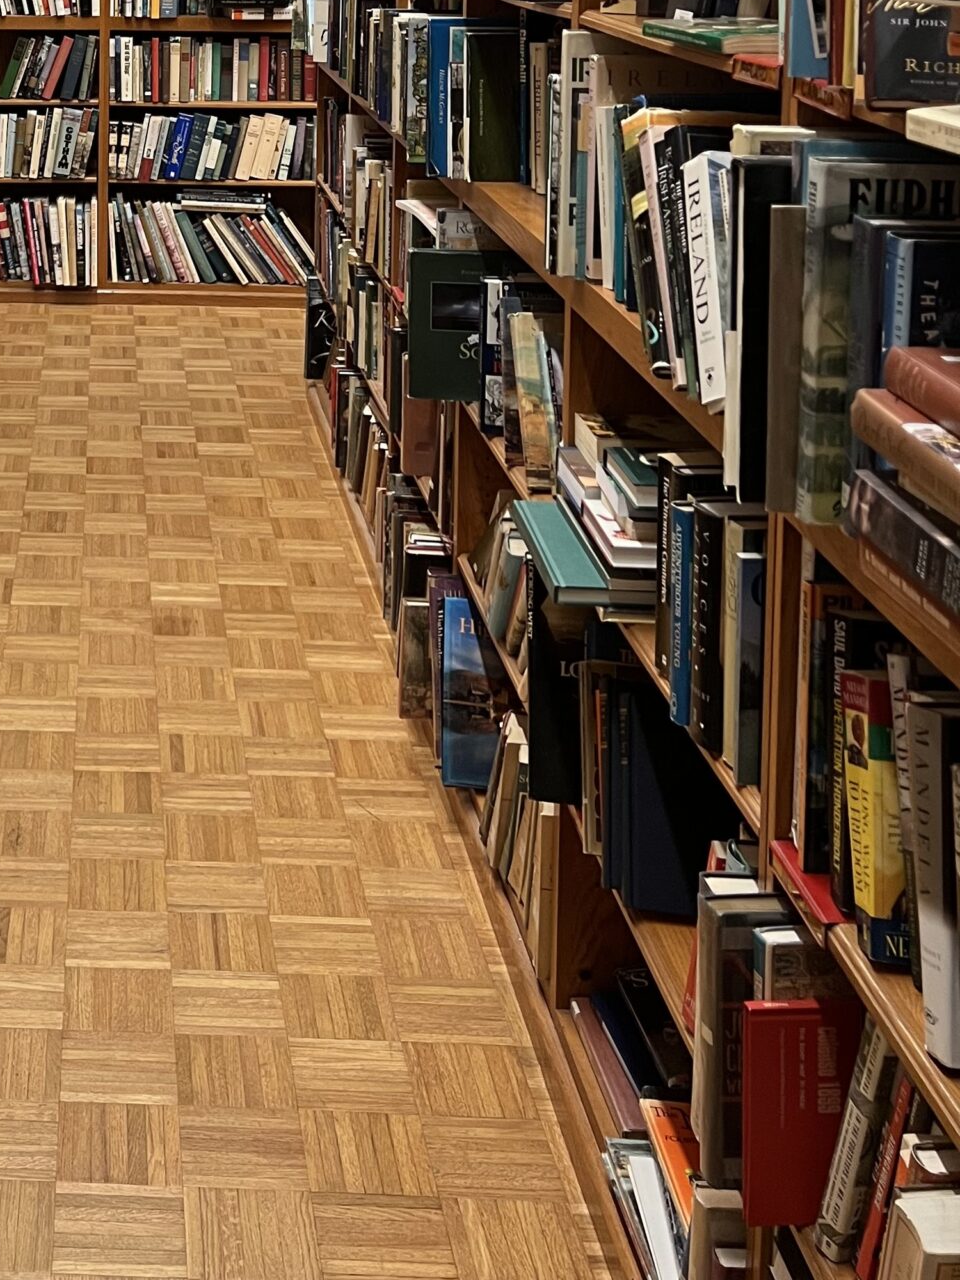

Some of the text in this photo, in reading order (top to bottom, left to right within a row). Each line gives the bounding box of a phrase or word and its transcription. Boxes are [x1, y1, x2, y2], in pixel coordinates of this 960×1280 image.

[889, 17, 948, 27] SIR JOHN
[904, 58, 960, 73] RICH
[677, 199, 685, 223] IRISH
[687, 177, 710, 326] IRELAND
[895, 257, 906, 315] THEATRE
[920, 279, 940, 342] THEA
[660, 476, 670, 604] The Ottoman Centuries
[672, 522, 683, 668] ADVENTUROUS YOUNG
[696, 530, 710, 657] VOICES
[833, 619, 846, 870] SAUL DAVID OPERATION THUNDERBOLT
[892, 684, 911, 814] MANDELA
[848, 779, 858, 801] TO
[913, 726, 931, 896] MANDELA
[817, 1081, 840, 1115] 1899
[842, 1137, 858, 1176] FOOTSTEPS
[831, 1199, 842, 1226] KURTZ
